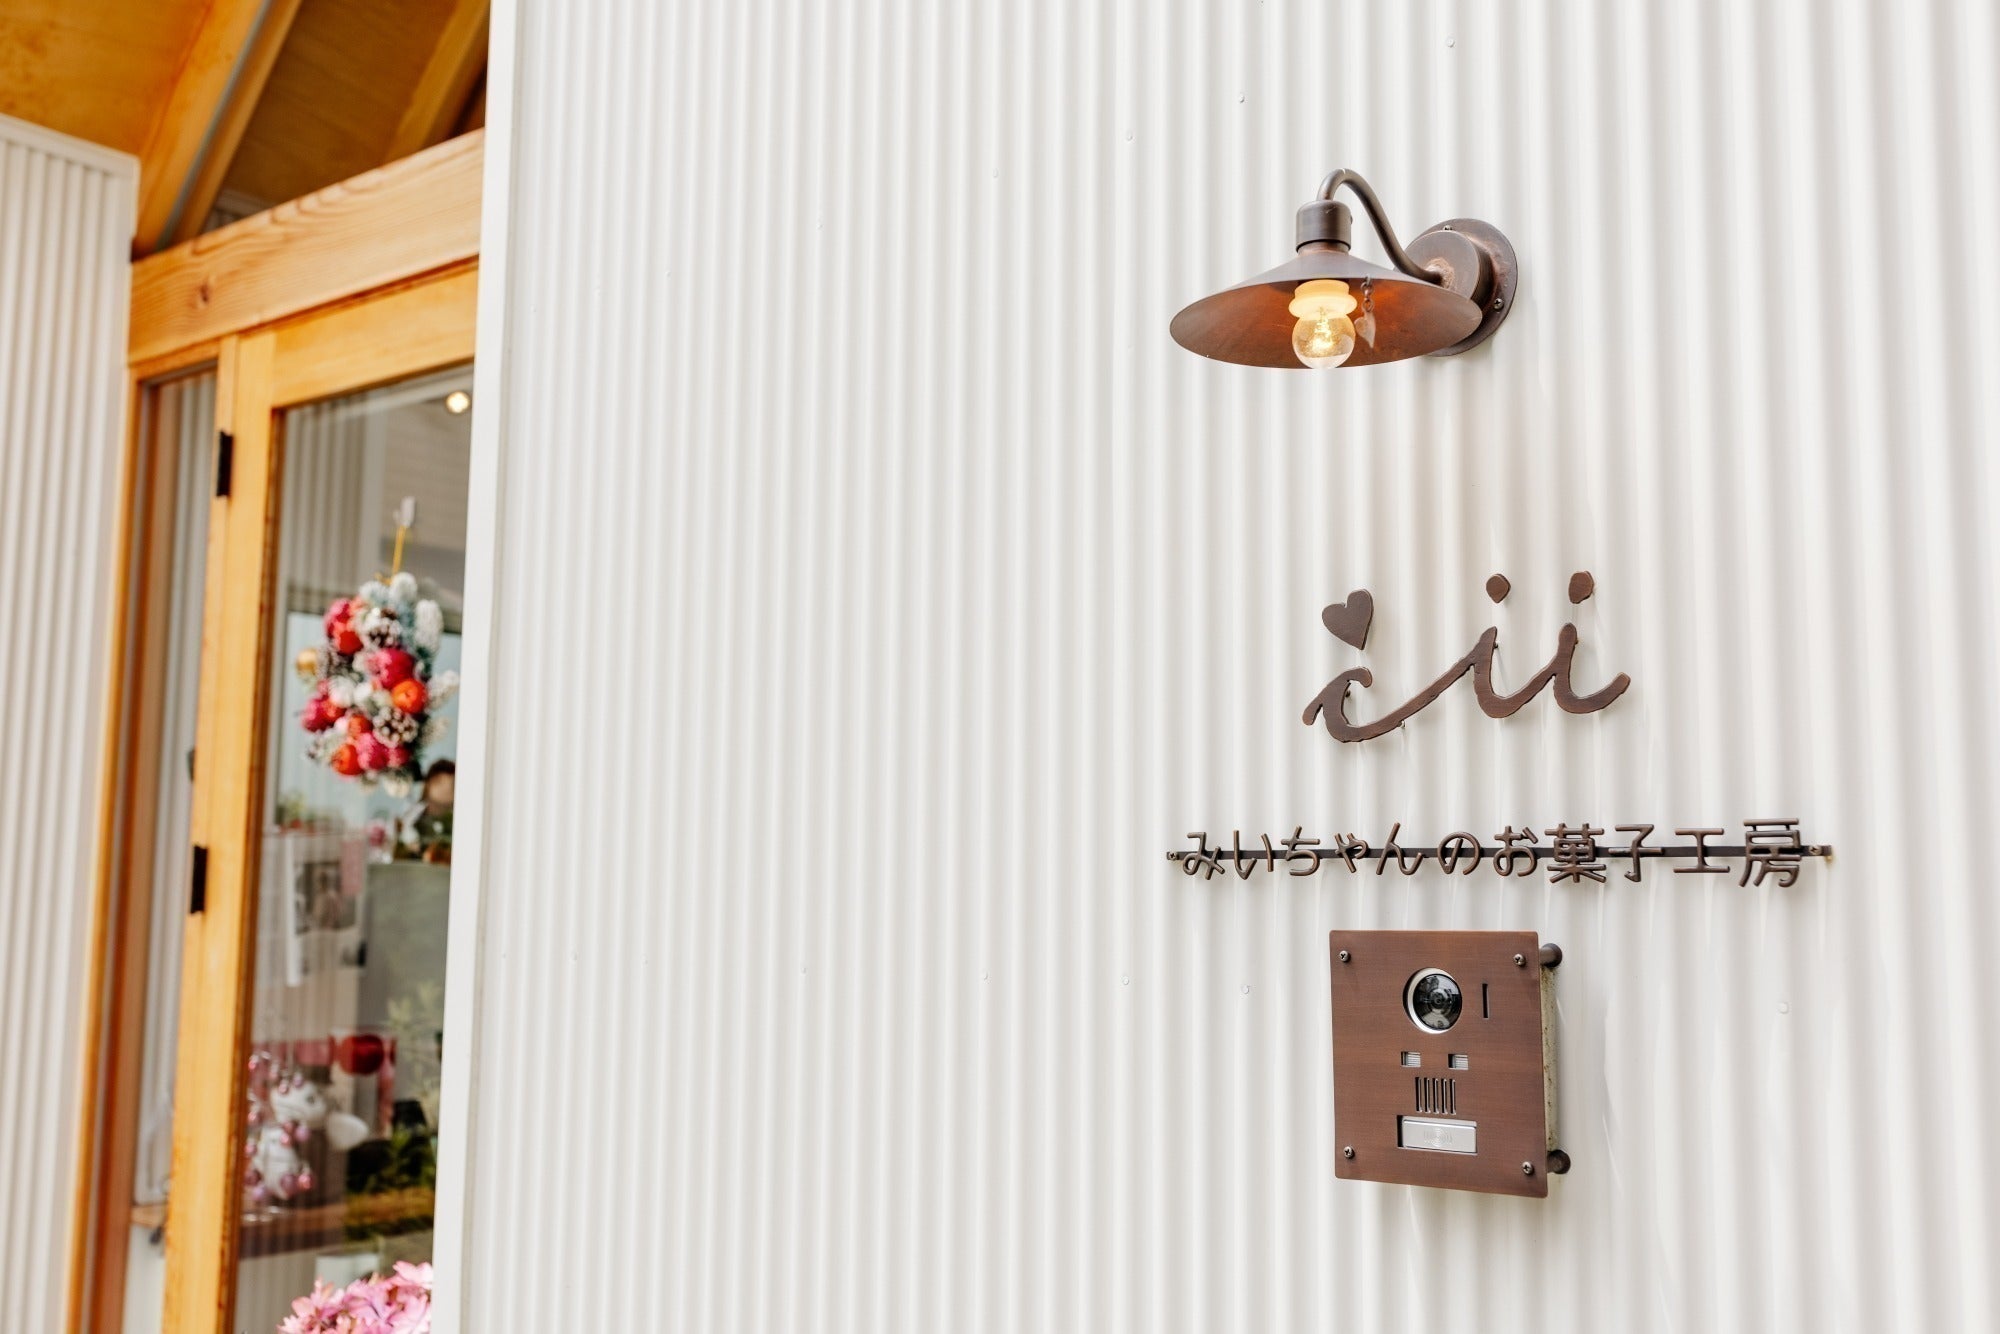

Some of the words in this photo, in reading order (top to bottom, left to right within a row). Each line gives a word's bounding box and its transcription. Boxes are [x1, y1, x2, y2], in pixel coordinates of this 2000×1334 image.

[1183, 819, 1800, 888] みいちゃんのお菓子工房
